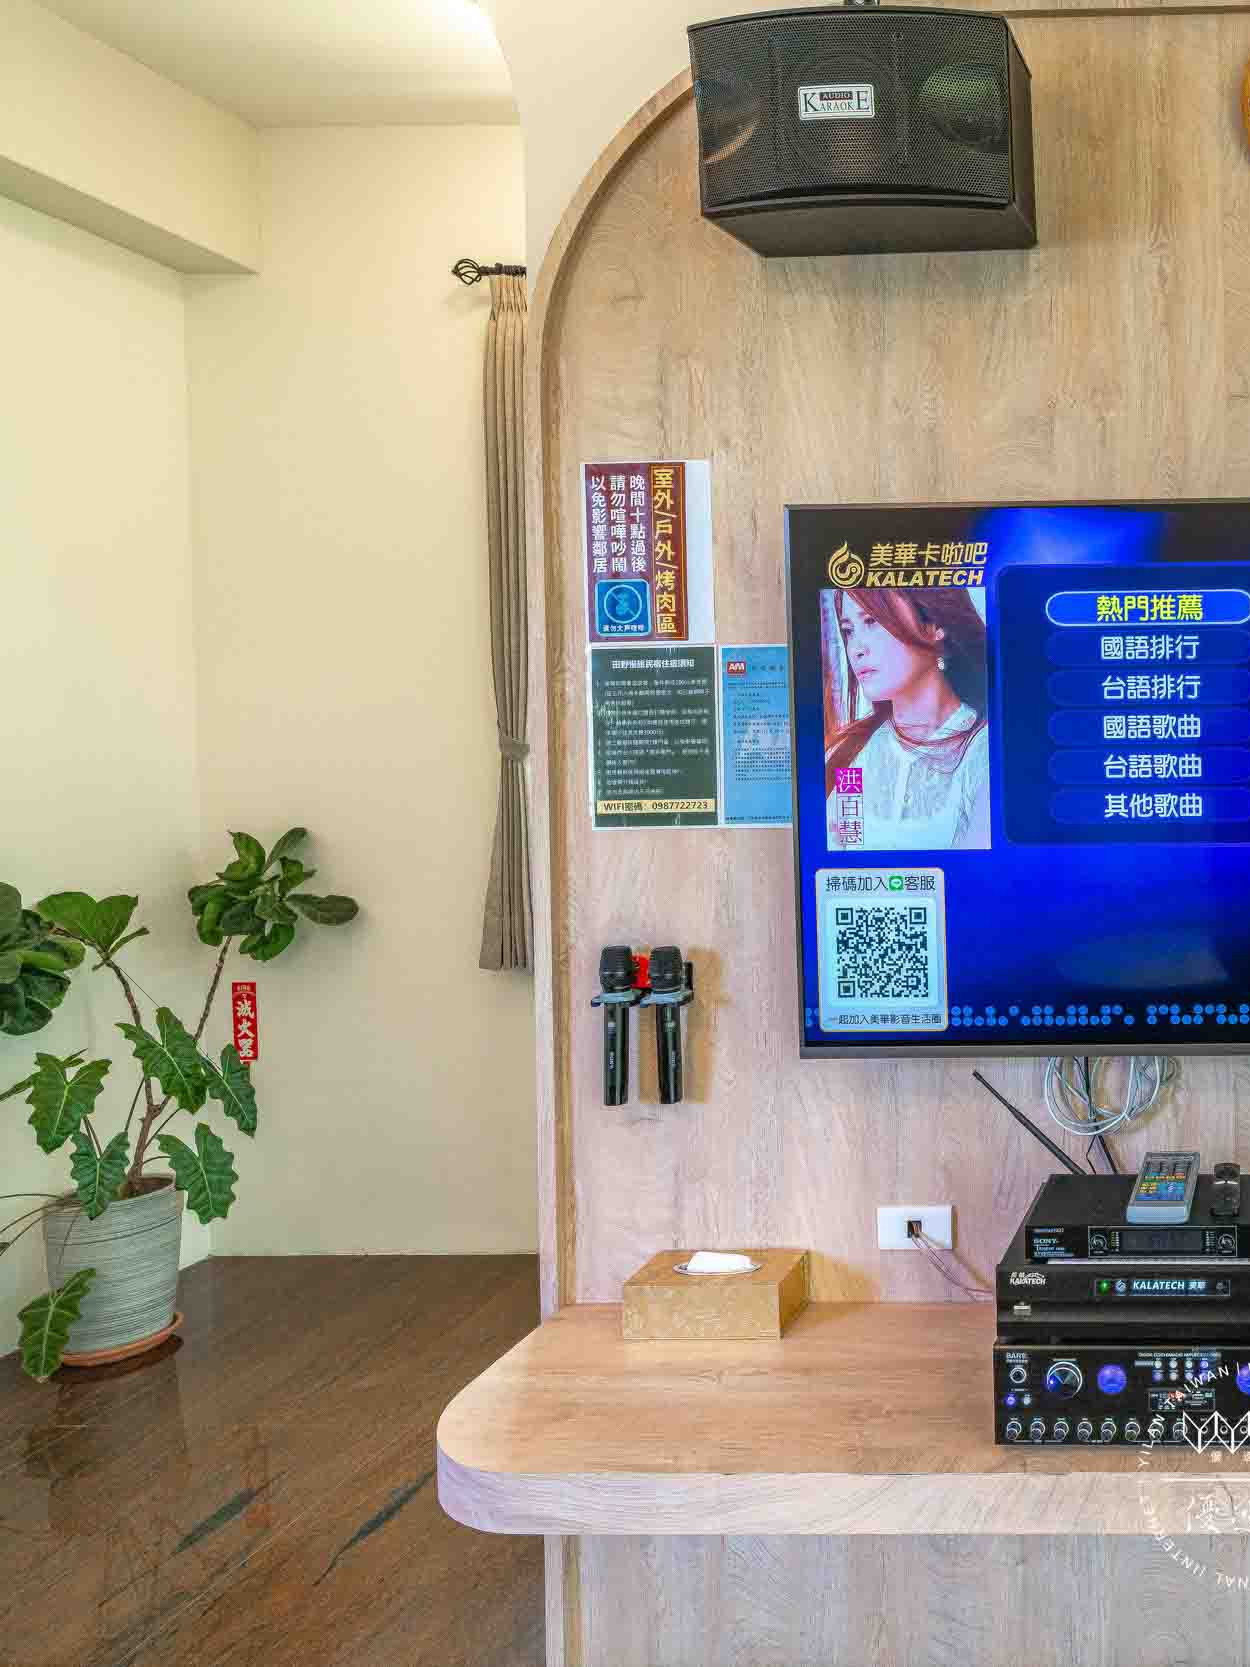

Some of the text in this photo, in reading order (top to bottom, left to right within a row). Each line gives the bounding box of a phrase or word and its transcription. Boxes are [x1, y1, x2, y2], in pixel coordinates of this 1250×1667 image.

[802, 90, 870, 112] KARAOKE
[822, 92, 852, 100] AUDIO
[591, 475, 608, 573] 以免影響鄰居
[610, 475, 628, 573] 請勿喧嘩吵鬧
[629, 475, 647, 572] 晚間十點過後
[869, 541, 988, 567] 美華卡啦吧
[865, 569, 984, 587] KALATECH
[1096, 594, 1204, 622] 熱門推薦
[1100, 635, 1200, 660] 國語排行
[1101, 675, 1201, 700] 台語排行
[1103, 714, 1201, 739] 國語歌曲
[1103, 754, 1202, 779] 台語歌曲
[651, 800, 708, 811] 0987722723
[1104, 793, 1203, 818] 其他歌曲
[826, 875, 937, 892] 掃碼加入 客服
[1133, 1281, 1185, 1290] KALATECH
